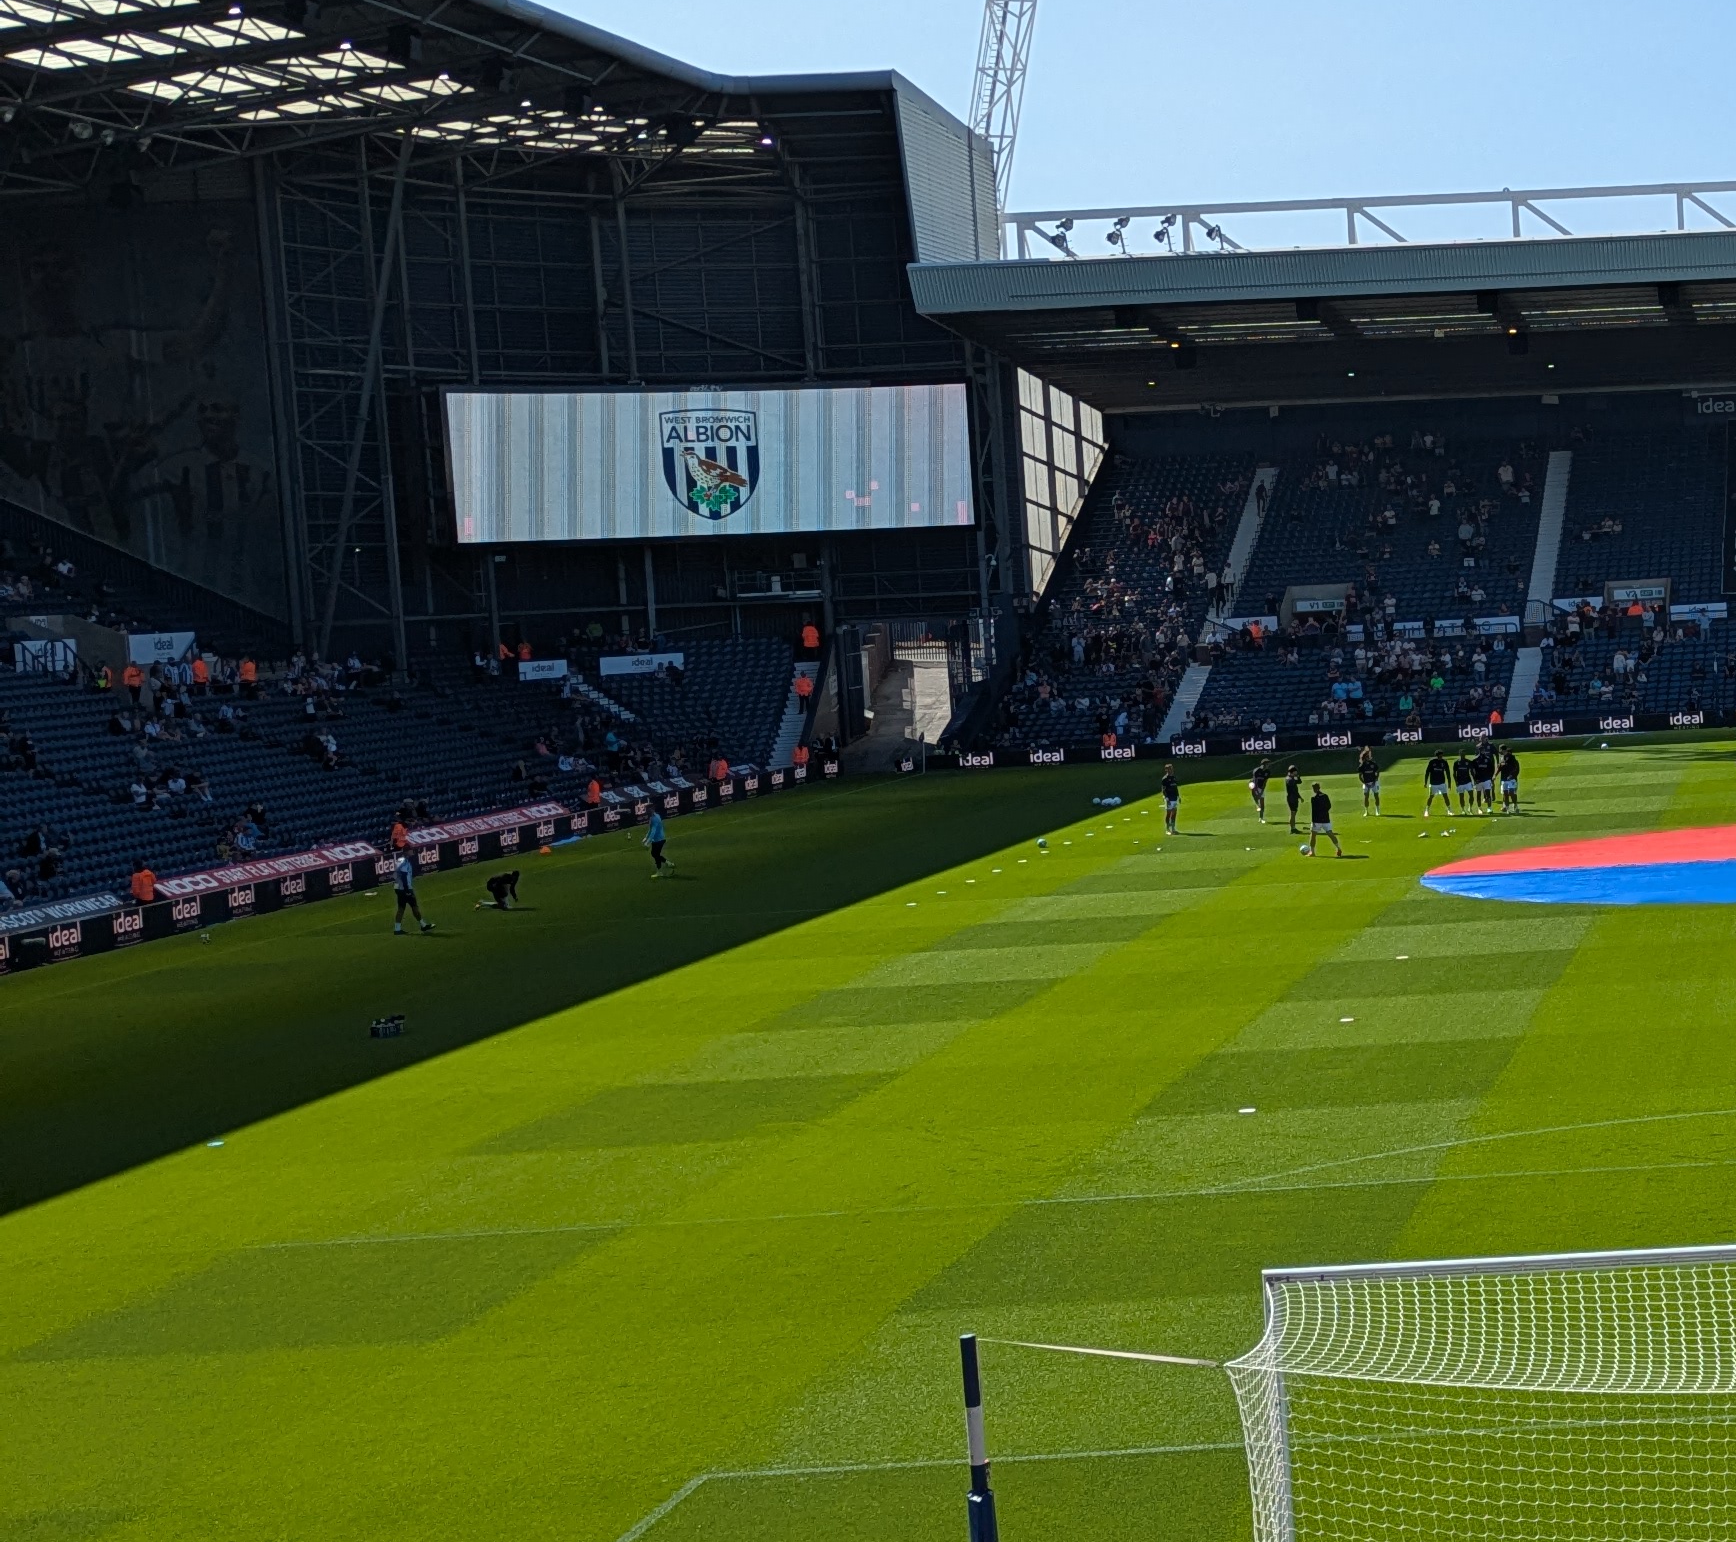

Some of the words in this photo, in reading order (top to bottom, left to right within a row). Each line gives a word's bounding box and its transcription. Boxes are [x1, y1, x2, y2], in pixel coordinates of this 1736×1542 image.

[664, 416, 691, 424] WEST
[666, 425, 751, 443] ALBION
[1529, 719, 1564, 734] ideal
[1599, 714, 1634, 731] ideal
[1669, 711, 1704, 726] ideal
[1317, 730, 1352, 747] ideal
[1458, 723, 1493, 739] ideal
[1101, 744, 1136, 760] ideal
[1171, 740, 1206, 756] ideal
[1241, 736, 1276, 752] ideal
[959, 751, 994, 767] ideal
[1029, 748, 1065, 764] ideal
[499, 826, 520, 847] ideal
[536, 819, 555, 839] ideal
[328, 842, 376, 862] NOCO
[417, 843, 440, 865] ideal
[458, 835, 479, 856] ideal
[328, 861, 353, 886] ideal
[155, 872, 219, 898] NOCO
[280, 872, 306, 896] ideal
[228, 883, 256, 908] ideal
[41, 893, 124, 920] WORKWEAR
[172, 895, 202, 922] ideal
[112, 906, 144, 935] ideal
[48, 920, 82, 950] ideal
